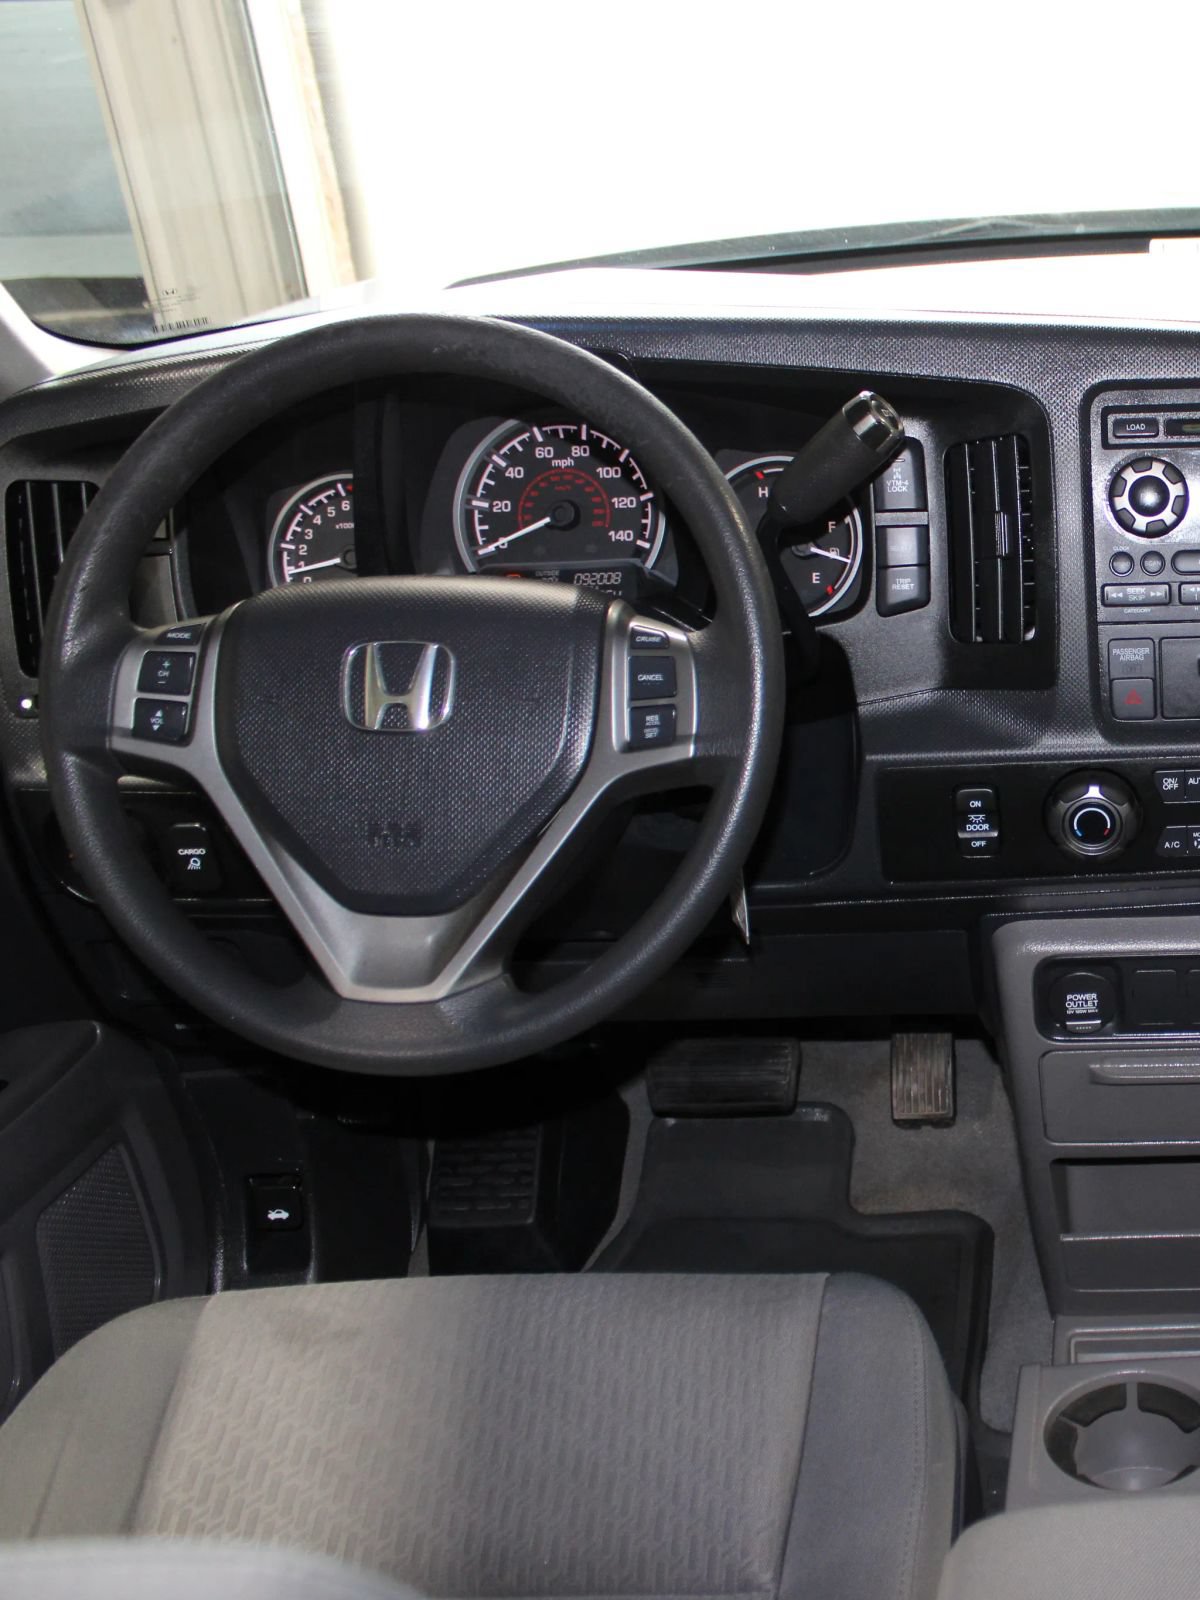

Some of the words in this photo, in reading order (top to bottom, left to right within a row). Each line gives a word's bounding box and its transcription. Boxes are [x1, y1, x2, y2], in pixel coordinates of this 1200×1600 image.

[535, 447, 554, 458] 60
[571, 446, 590, 457] 80
[552, 459, 574, 469] mph
[505, 467, 524, 478] 40
[596, 467, 621, 478] 100
[758, 487, 768, 498] H
[342, 501, 350, 511] 6
[493, 501, 511, 512] 20
[612, 497, 636, 508] 120
[327, 507, 336, 517] 5
[313, 515, 321, 525] 4
[828, 522, 836, 533] F
[304, 529, 313, 539] 3
[608, 530, 633, 541] 140
[299, 545, 307, 555] 2
[574, 572, 622, 585] 092008
[813, 572, 820, 583] E
[1112, 647, 1150, 656] PASSENGER
[1162, 777, 1178, 785] ON/
[971, 840, 986, 848] OFF
[1164, 840, 1180, 849] A/C
[1066, 993, 1097, 1001] POWER
[1065, 1000, 1098, 1008] OUTLET
